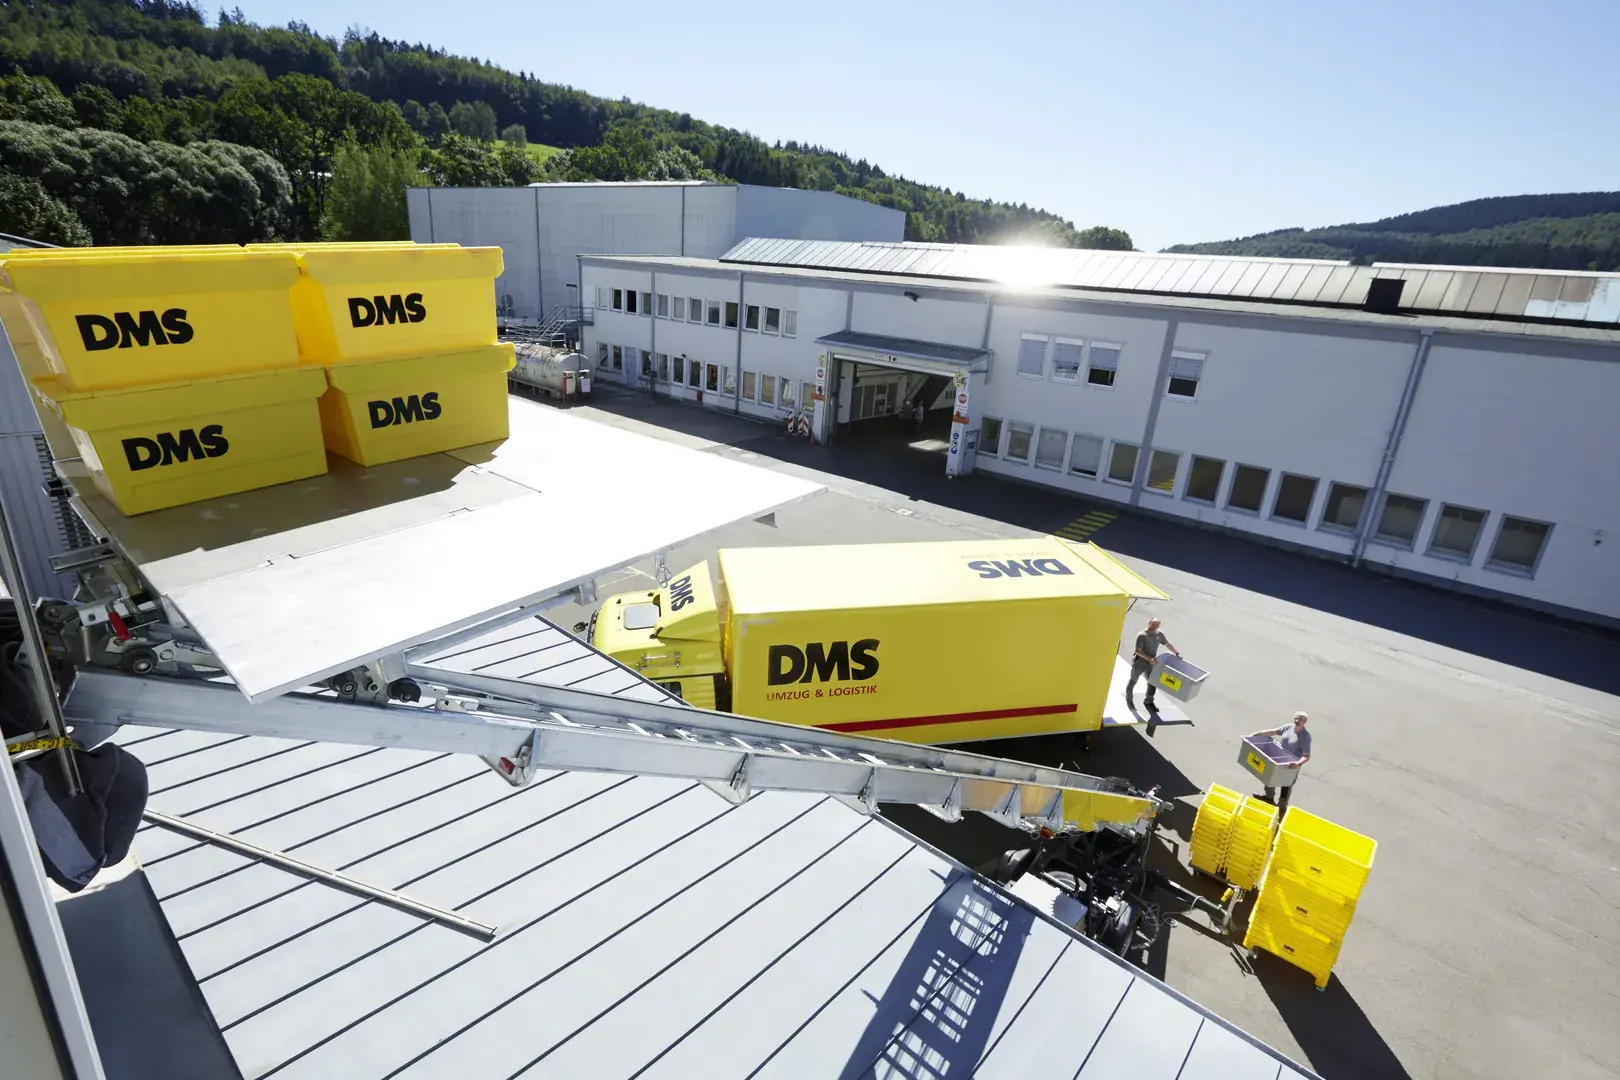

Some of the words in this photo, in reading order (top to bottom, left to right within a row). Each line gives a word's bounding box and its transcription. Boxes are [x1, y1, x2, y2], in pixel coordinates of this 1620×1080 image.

[348, 292, 427, 328] DMS
[75, 308, 194, 351] DMS
[368, 391, 442, 430] DMS
[121, 424, 230, 472] DMS
[967, 558, 1075, 579] DMS
[669, 575, 694, 611] DMS
[767, 638, 880, 686] DMS
[766, 690, 810, 702] UMZUG
[815, 688, 824, 697] &
[828, 685, 877, 697] LOGISTIK
